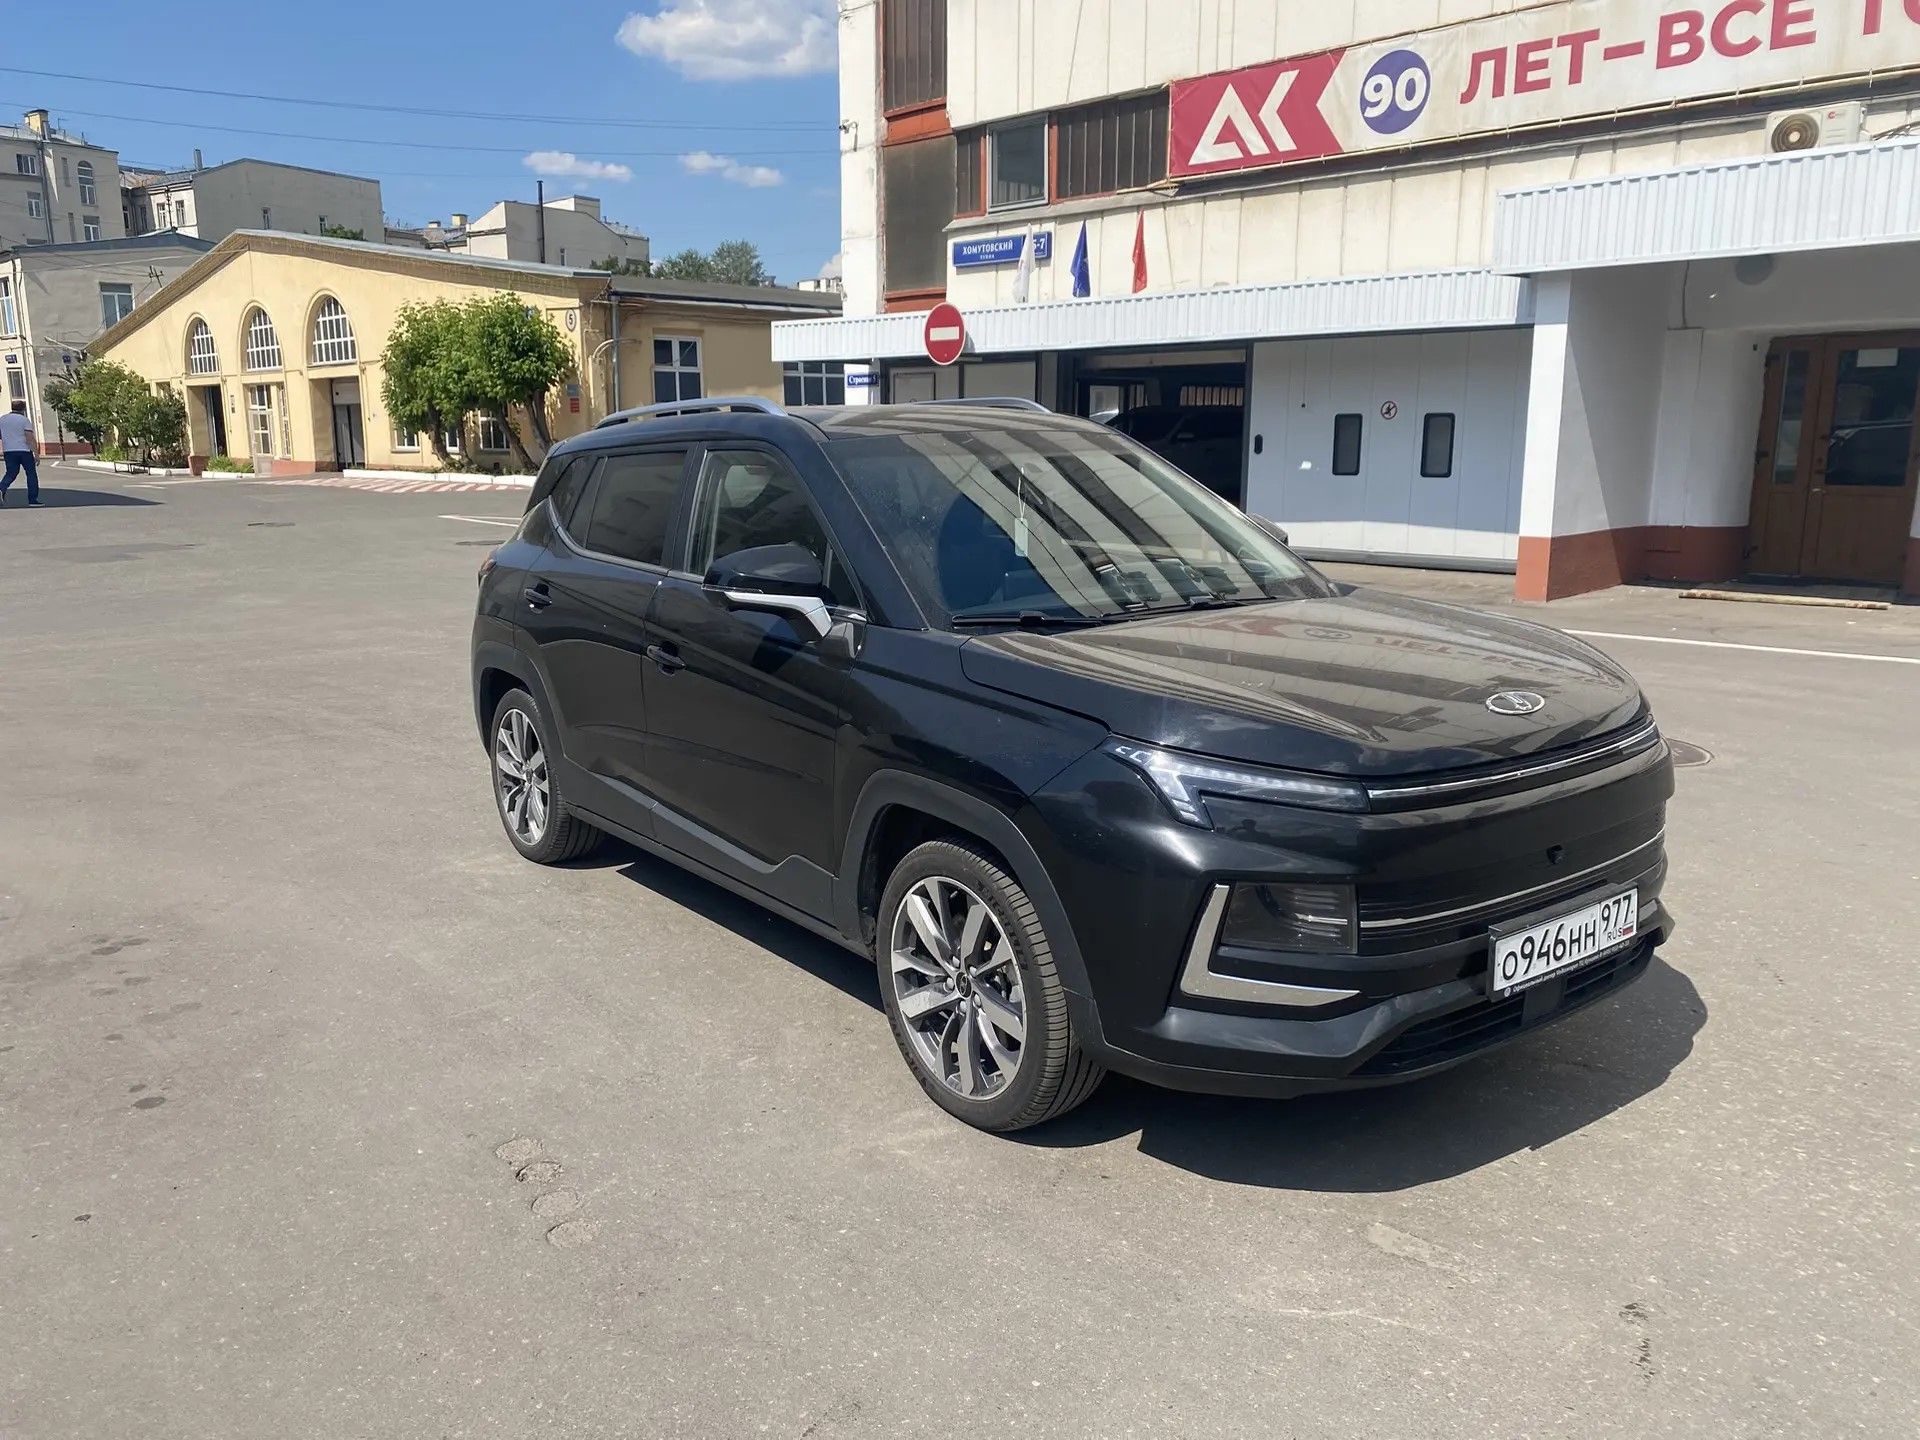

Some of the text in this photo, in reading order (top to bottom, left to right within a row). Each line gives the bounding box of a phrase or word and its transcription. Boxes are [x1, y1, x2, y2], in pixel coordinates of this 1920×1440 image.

[1363, 67, 1427, 118] 90
[962, 239, 1013, 255] ХОМУТОВСКИЙ
[1502, 920, 1596, 981] О946НН
[1601, 893, 1632, 932] 977
[1607, 927, 1624, 941] RUS
